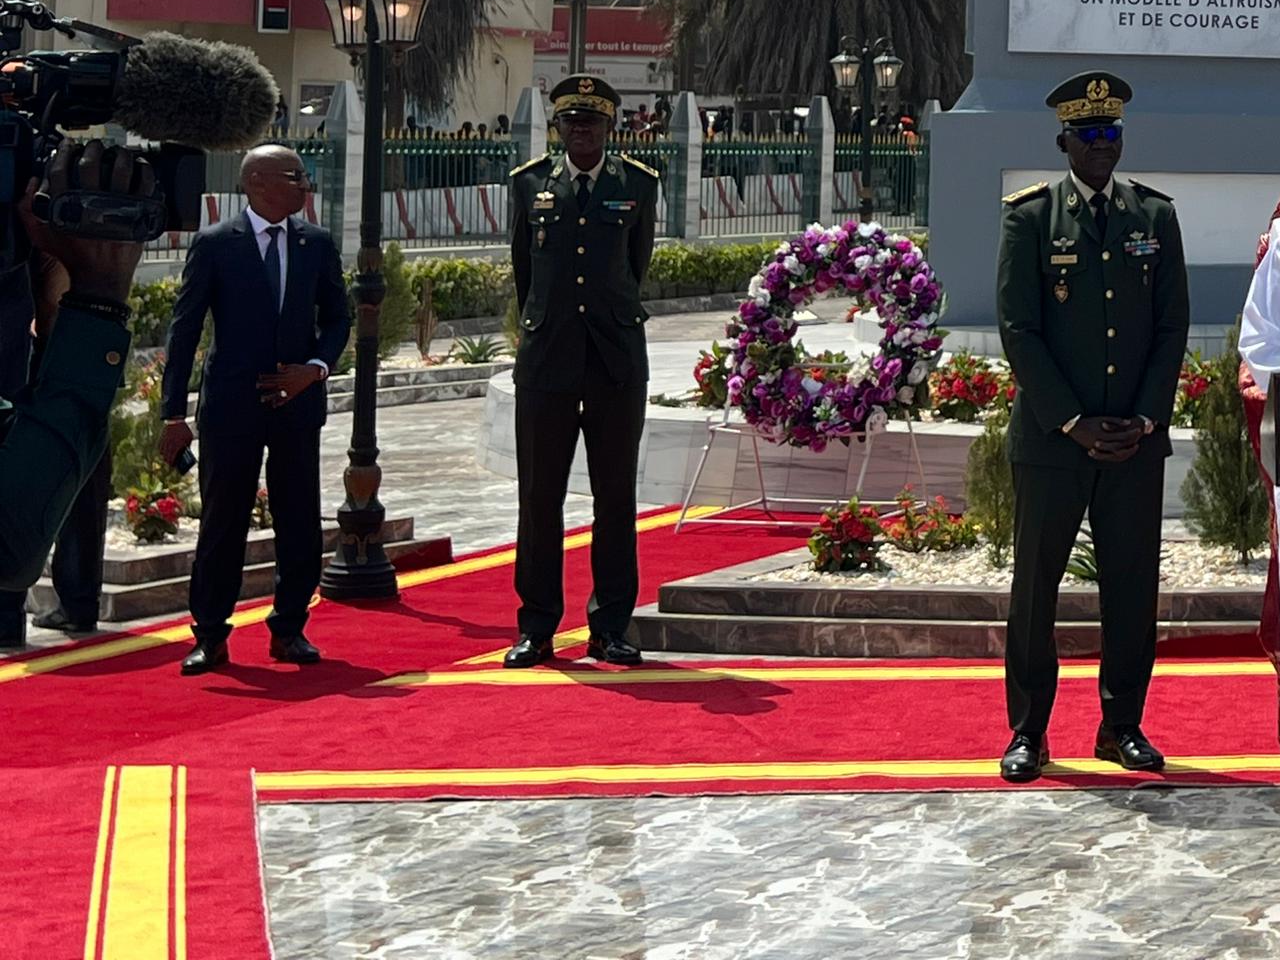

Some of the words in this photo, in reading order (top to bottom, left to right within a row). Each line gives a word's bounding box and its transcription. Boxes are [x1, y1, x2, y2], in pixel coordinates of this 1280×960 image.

[1118, 11, 1136, 27] ET
[1141, 12, 1164, 28] DE
[1169, 12, 1260, 30] COURAGE
[597, 41, 620, 51] tout
